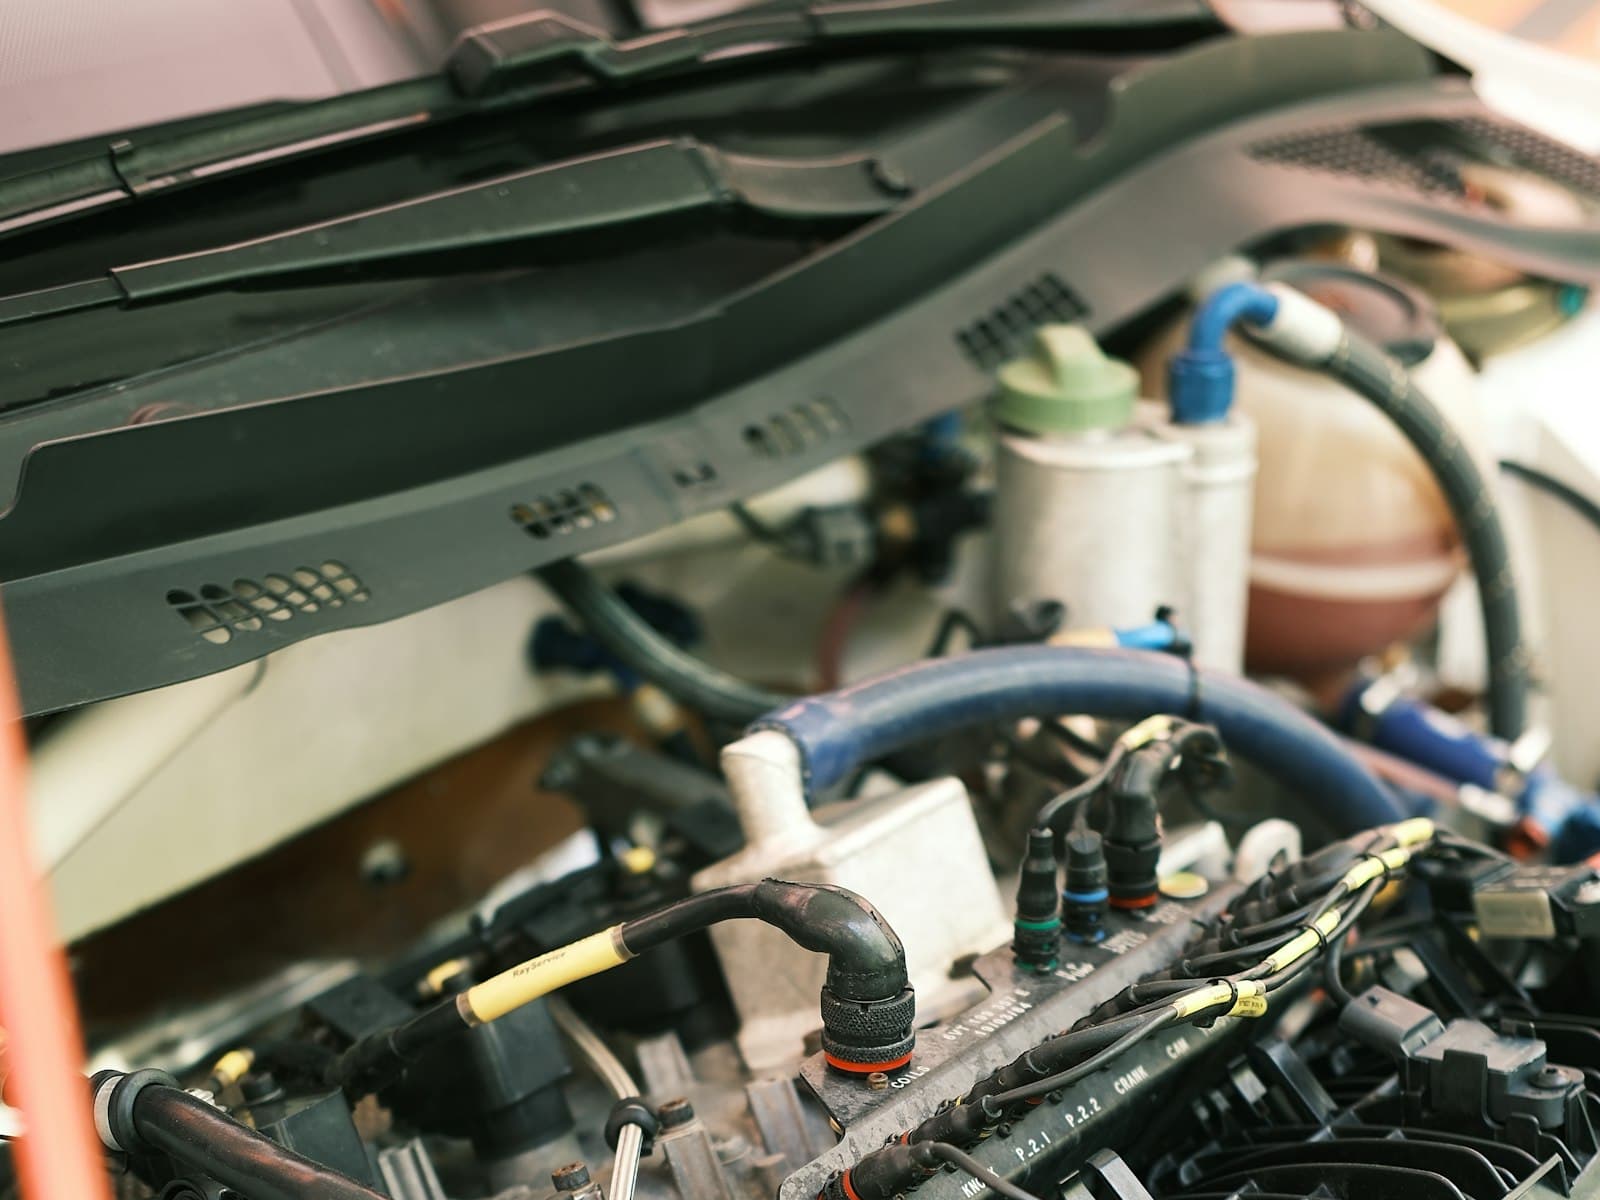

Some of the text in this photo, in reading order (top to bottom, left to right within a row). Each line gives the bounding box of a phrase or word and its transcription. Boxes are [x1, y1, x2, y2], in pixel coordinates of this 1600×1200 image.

[1165, 1037, 1190, 1060] CAM
[890, 1065, 931, 1089] COILS
[1113, 1065, 1149, 1095] CRANK
[1064, 1097, 1102, 1128] P_2.2
